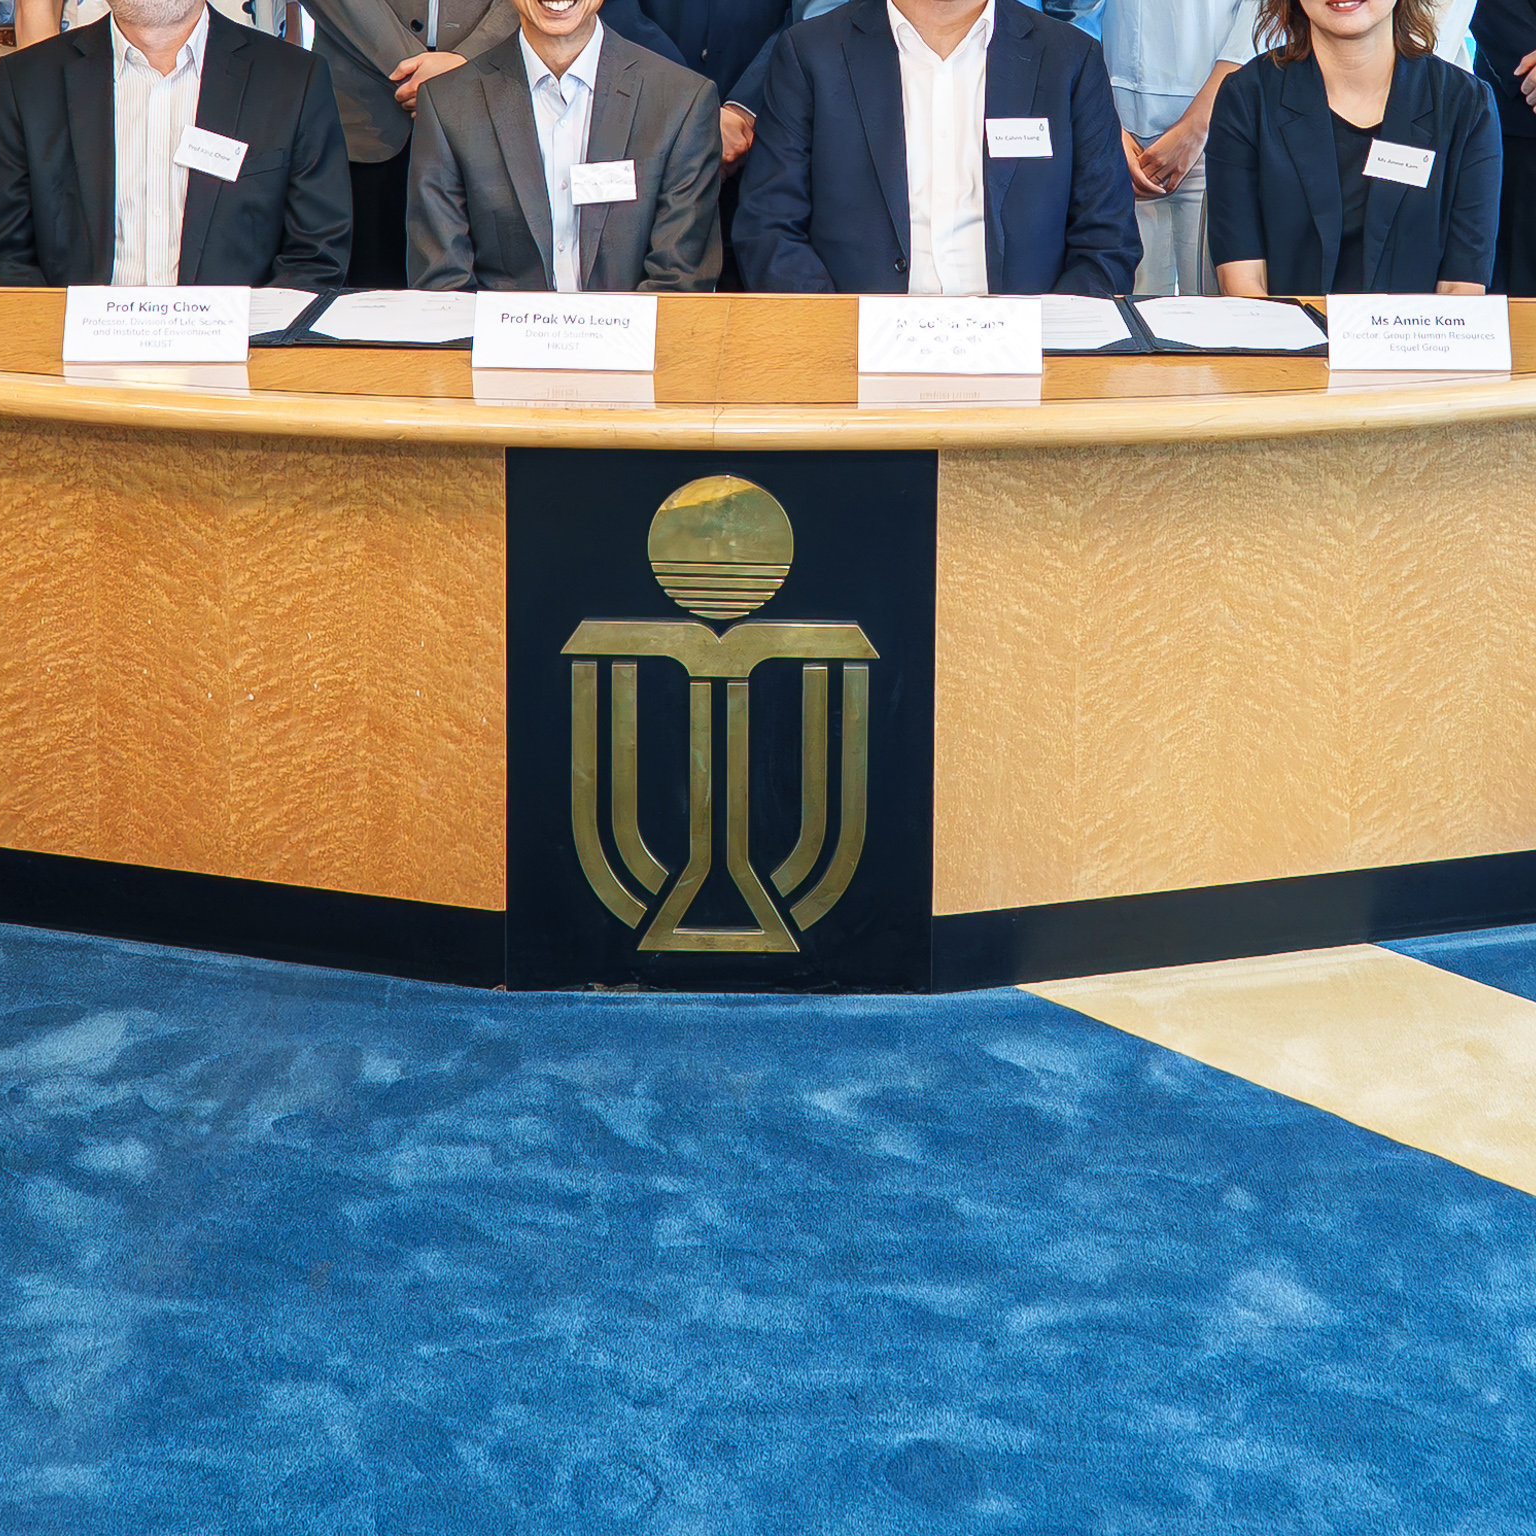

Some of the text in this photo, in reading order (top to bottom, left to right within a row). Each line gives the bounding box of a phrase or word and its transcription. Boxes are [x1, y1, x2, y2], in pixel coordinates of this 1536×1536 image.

[106, 301, 211, 315] Prof King Chow
[130, 317, 166, 326] Division
[168, 317, 178, 326] of
[501, 312, 631, 329] Prof Pak Wo Leung
[1371, 315, 1466, 326] Ms Annie Kam
[93, 328, 111, 336] and
[113, 328, 150, 336] Institute
[152, 328, 162, 336] of
[525, 329, 550, 338] Dean
[552, 329, 561, 338] of
[1383, 331, 1411, 341] Group
[1413, 331, 1447, 340] Human
[1449, 331, 1495, 340] Resources
[139, 339, 173, 348] HKUST
[1389, 343, 1450, 353] Esquel Group
